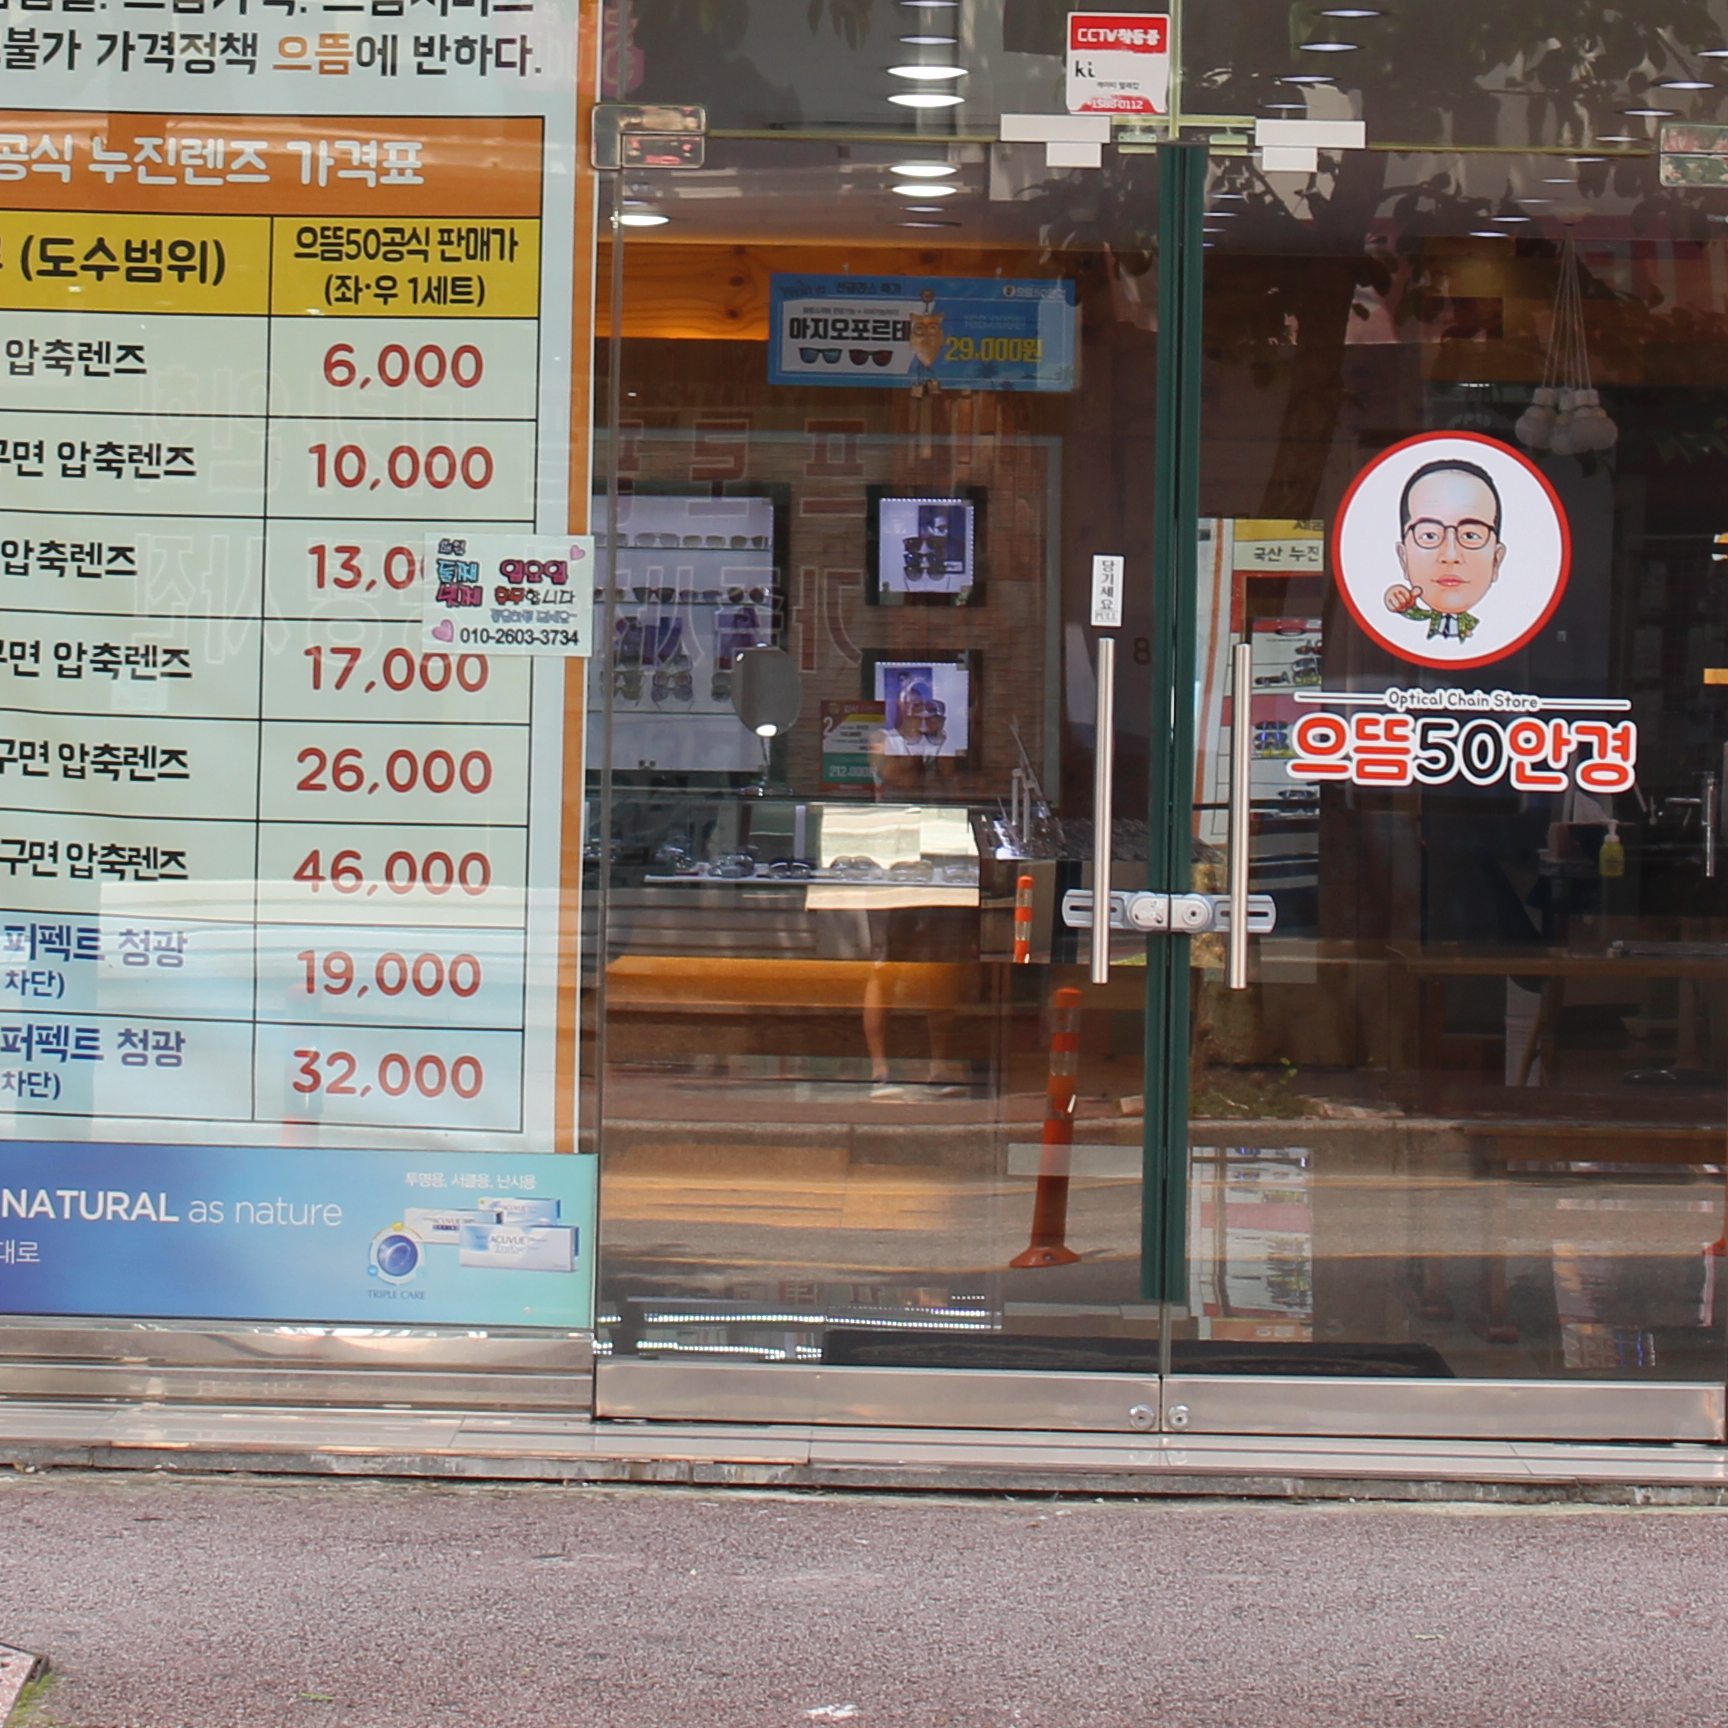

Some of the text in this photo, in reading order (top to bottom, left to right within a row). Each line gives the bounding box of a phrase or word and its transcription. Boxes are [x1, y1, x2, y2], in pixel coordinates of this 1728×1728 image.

[97, 30, 259, 75] 가격정책
[272, 33, 399, 78] 으뜸에
[412, 34, 543, 78] 반하다.
[88, 136, 271, 187] 누진렌즈
[287, 139, 425, 188] 가격표
[19, 234, 227, 288] (도수범위)
[293, 226, 520, 263] 으뜸50공식 판매가
[407, 273, 486, 308] 1세트)
[4, 337, 148, 377] 압축렌즈
[323, 343, 485, 390] 6,000
[460, 627, 580, 646] 010-2603-3734
[1388, 687, 1539, 711] Optical Chain Store
[1287, 713, 1638, 793] 으뜸50안경
[3, 923, 105, 962] 퍼펙트
[117, 927, 189, 969] 청광
[4, 969, 66, 999] 차단)
[296, 949, 482, 999] 19,000
[368, 1289, 426, 1301] TRIPLE CARE
